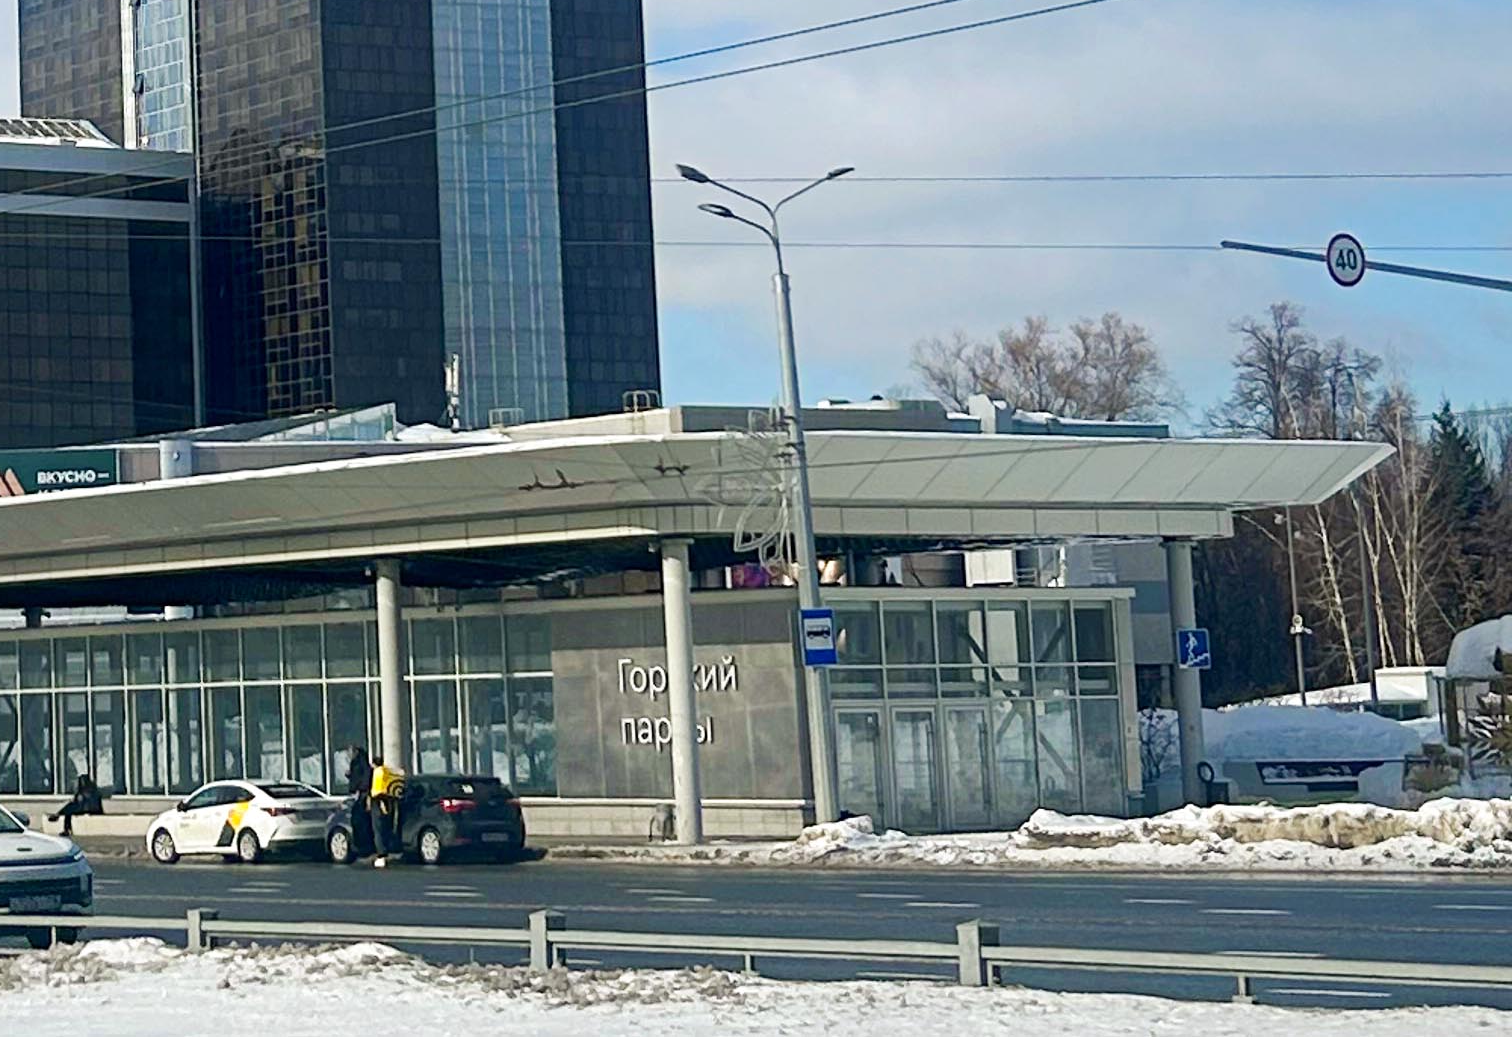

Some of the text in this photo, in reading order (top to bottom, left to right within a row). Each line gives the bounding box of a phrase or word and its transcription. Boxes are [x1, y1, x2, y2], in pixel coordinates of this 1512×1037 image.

[1336, 249, 1357, 270] 40
[37, 470, 96, 484] ВКУСНО
[618, 655, 738, 701] Горий
[620, 717, 713, 752] пары
